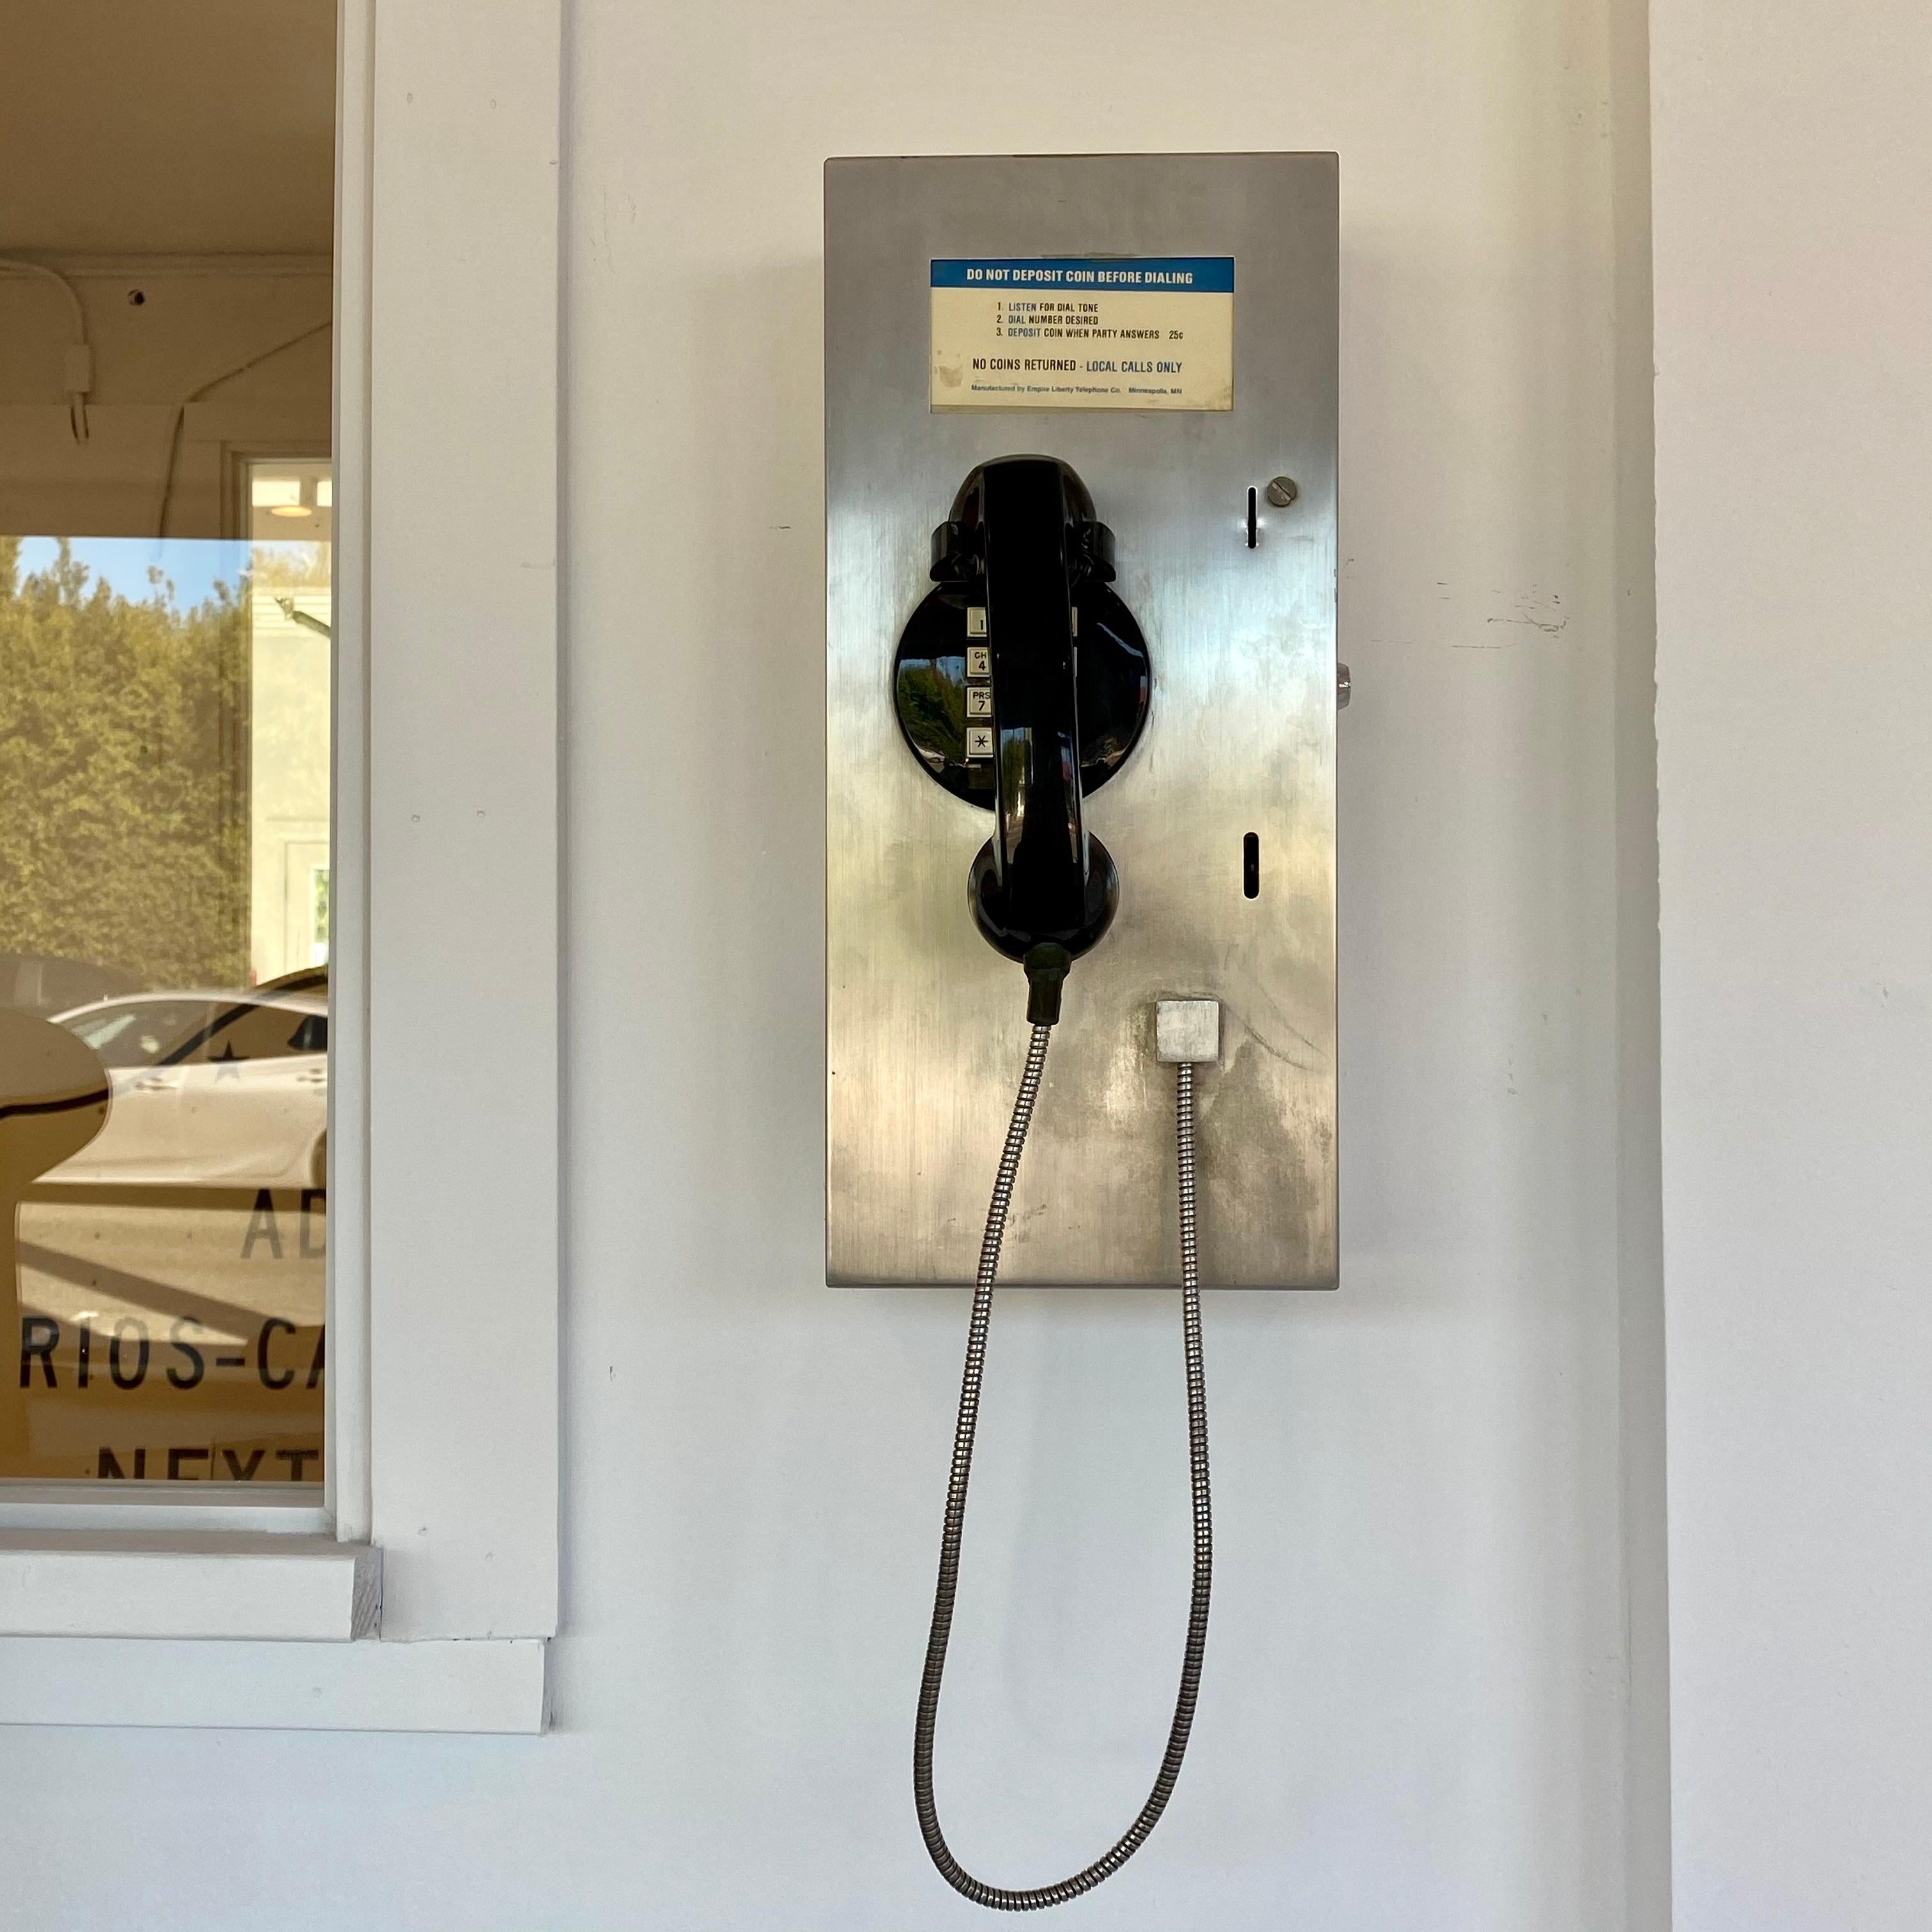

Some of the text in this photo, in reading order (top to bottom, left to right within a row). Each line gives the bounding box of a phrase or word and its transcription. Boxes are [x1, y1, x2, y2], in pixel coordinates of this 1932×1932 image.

[967, 268, 1193, 284] DO NOT DEPOSIT COIN BEFORE DIALING
[1008, 302, 1036, 312] LISTEN
[1039, 303, 1054, 312] FOR
[1057, 303, 1075, 312] DIAL
[1078, 303, 1098, 312] TONE
[997, 314, 1098, 325] 2. DIAL NUMBER DESIRED
[996, 327, 1003, 337] 3.
[1008, 328, 1041, 337] DEPOSIT
[1044, 328, 1062, 337] COIN
[1066, 328, 1089, 338] WHEN
[1092, 329, 1117, 338] PARTY
[1120, 329, 1160, 339] ANSWERS
[972, 358, 986, 369] NO
[990, 358, 1020, 370] COINS
[1024, 359, 1076, 371] RETURNED
[1087, 360, 1117, 372] LOCAL
[1121, 361, 1153, 372] CALLS
[1156, 361, 1182, 373] ONLY
[1017, 385, 1025, 393] by
[980, 619, 984, 631] 1
[978, 661, 986, 671] 4
[978, 700, 985, 711] 7
